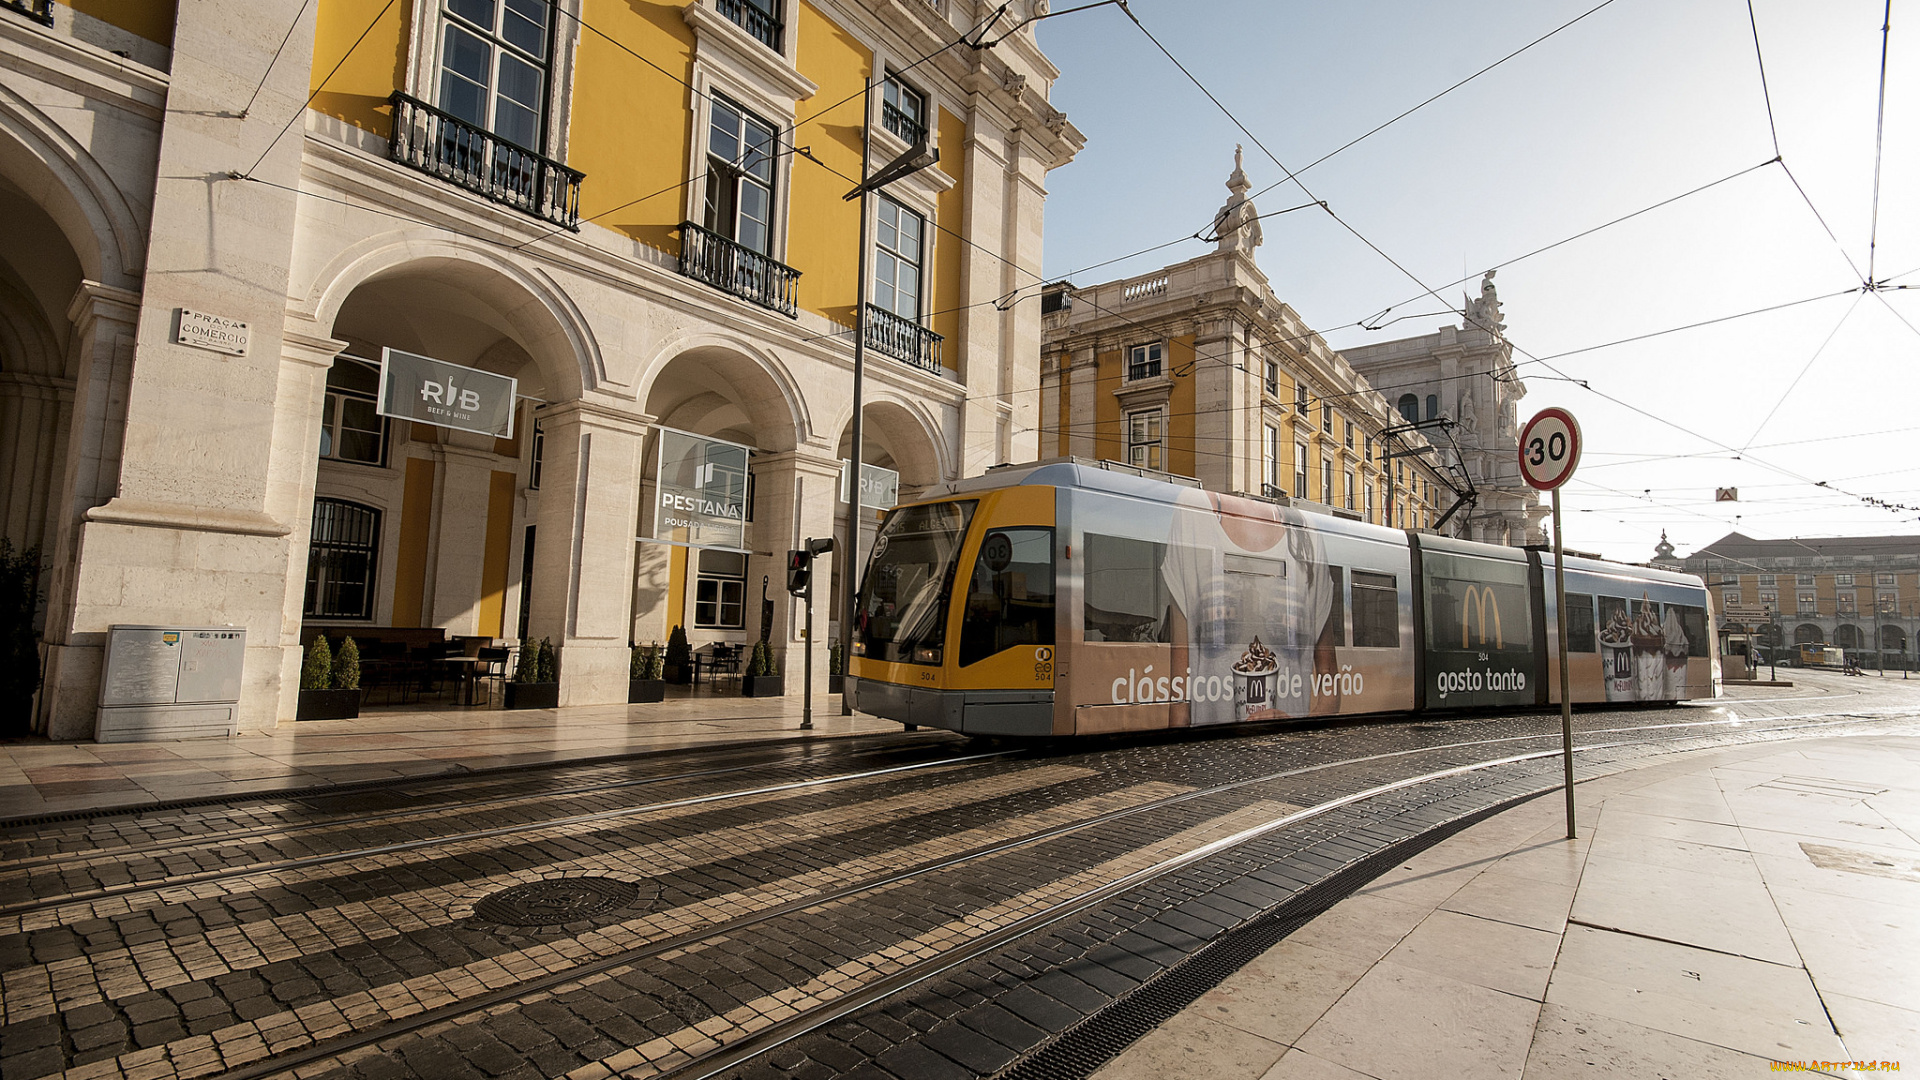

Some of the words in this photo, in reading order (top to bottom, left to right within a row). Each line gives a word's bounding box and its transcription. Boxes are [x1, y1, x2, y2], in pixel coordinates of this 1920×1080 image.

[194, 313, 239, 329] PRAÇA
[183, 324, 247, 344] COMERCIO
[427, 406, 444, 416] BEEF
[453, 411, 471, 421] WINE
[1529, 431, 1566, 466] 30
[662, 493, 738, 518] PESTANA
[1478, 652, 1489, 662] 504
[921, 671, 936, 681] 504
[1035, 673, 1051, 681] 504
[1111, 664, 1234, 704] clássicos
[1277, 666, 1302, 699] de
[1310, 664, 1363, 697] verão
[1437, 666, 1482, 699] gosto
[1486, 666, 1526, 691] tanto
